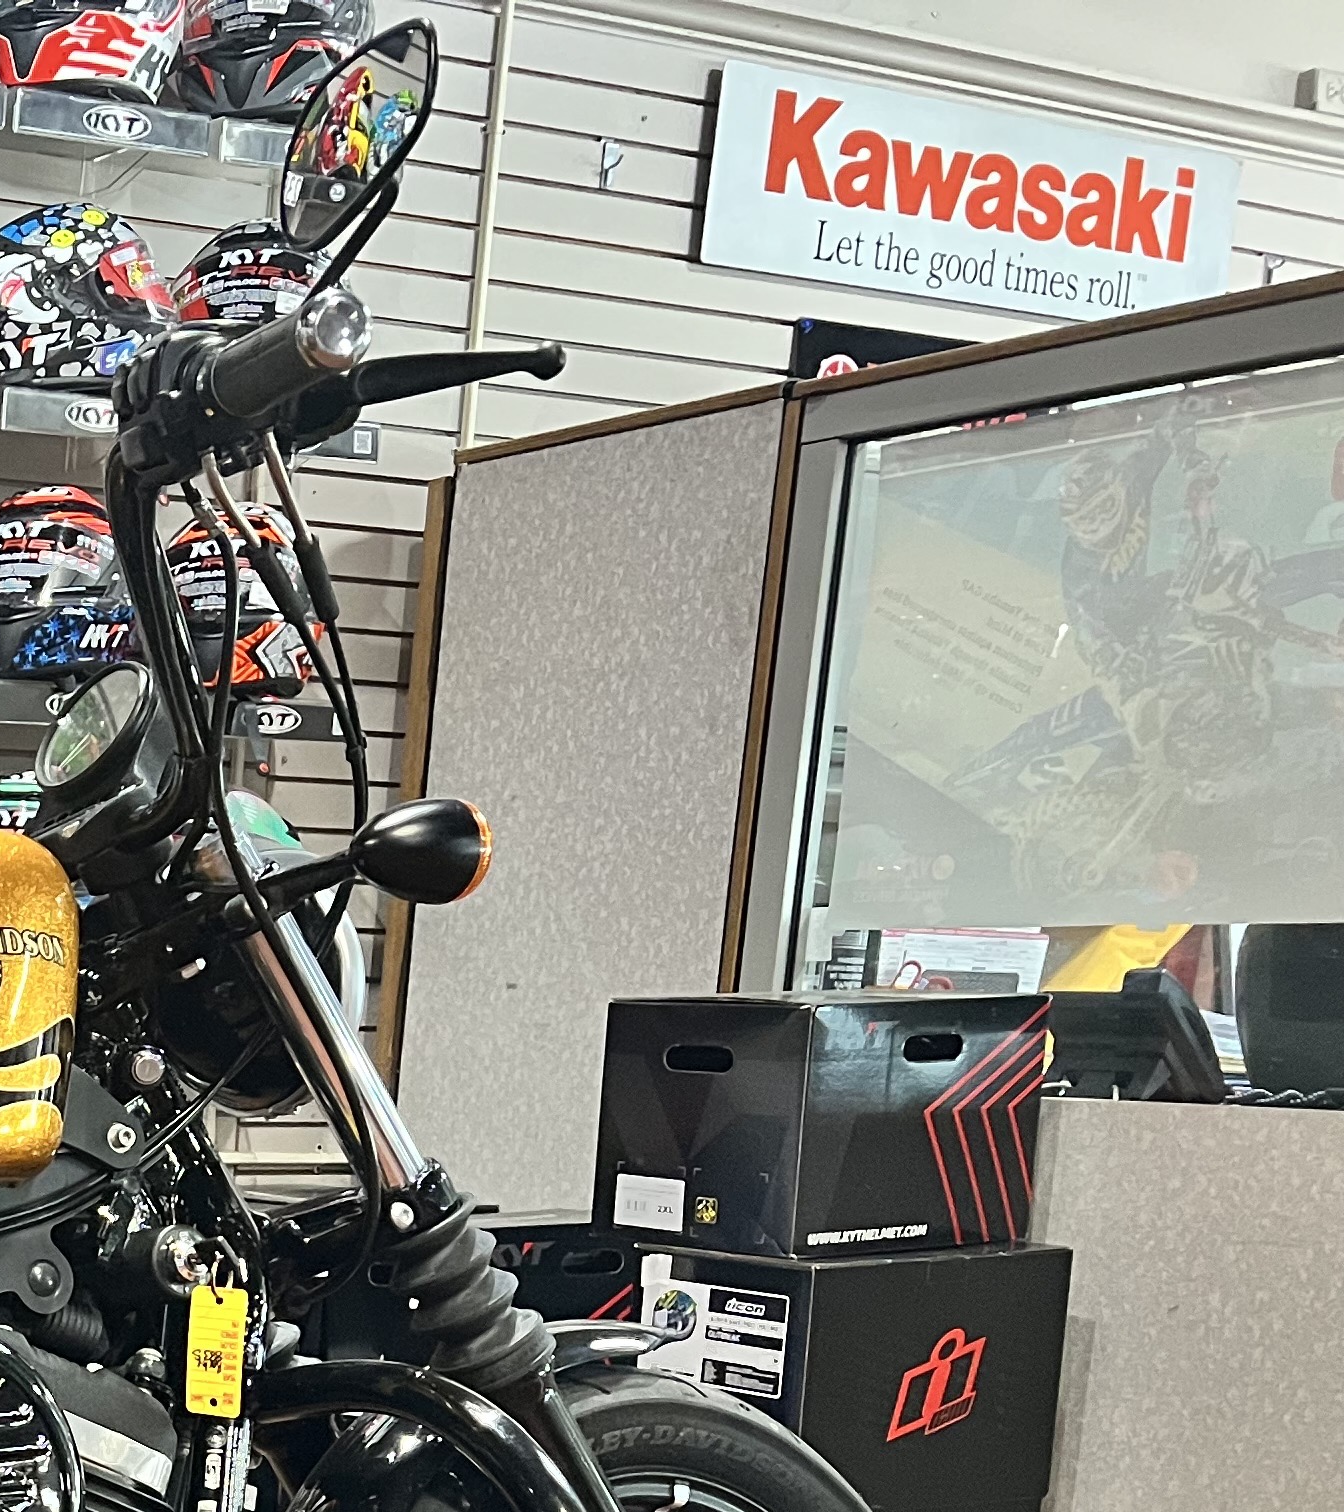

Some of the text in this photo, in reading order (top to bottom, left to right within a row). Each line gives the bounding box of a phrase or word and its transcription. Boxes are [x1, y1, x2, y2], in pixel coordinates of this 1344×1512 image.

[88, 109, 148, 134] KYT
[763, 88, 1195, 262] Kawasaki
[813, 220, 863, 266] Let
[875, 232, 919, 275] the
[926, 248, 997, 289] good
[1004, 252, 1079, 302] times
